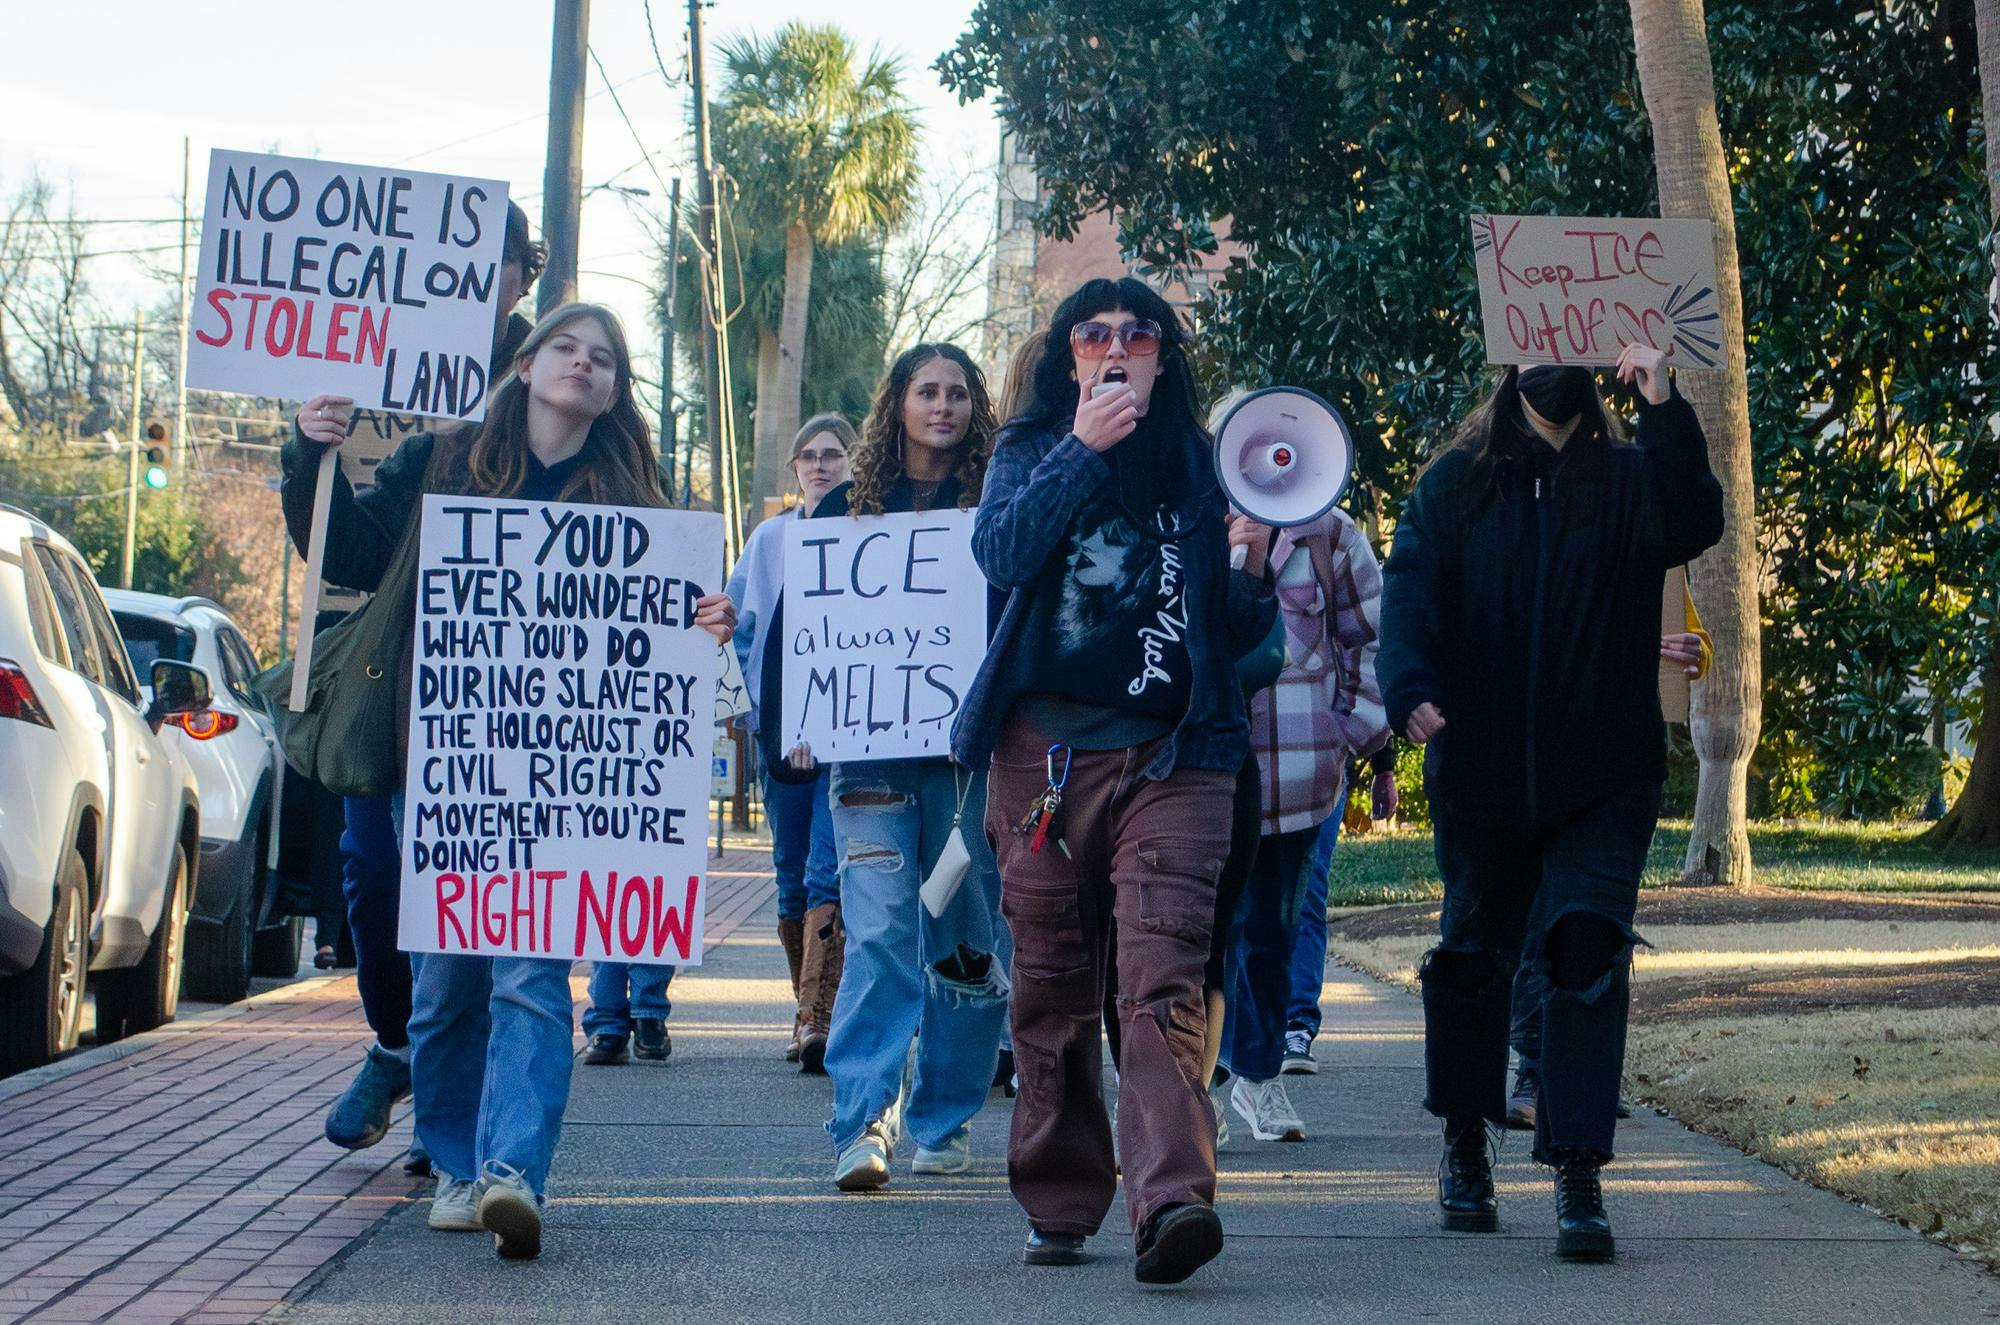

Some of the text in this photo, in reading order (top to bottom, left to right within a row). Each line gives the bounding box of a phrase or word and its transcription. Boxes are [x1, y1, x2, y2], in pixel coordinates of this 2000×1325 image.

[223, 165, 488, 248] NO ONE IS
[216, 229, 496, 309] ILLEGAL ON
[1488, 217, 1574, 298] Keep
[196, 288, 391, 367] STOLEN
[381, 348, 485, 418] LAND
[442, 507, 649, 568] IF YOU'D
[802, 528, 950, 598] ICE
[423, 568, 705, 630] EVER WONDERED
[423, 620, 650, 668] WHAT YOU'D DO
[794, 614, 950, 659] always
[419, 664, 546, 709] DURING
[557, 667, 697, 718] SLAVERY,
[801, 664, 959, 736] MELTS
[419, 711, 694, 759] THE HOLOCAUST, OR
[423, 753, 665, 799] CIVIL RIGHTS
[575, 802, 686, 845] YOU'RE
[414, 838, 538, 874] DOING IT
[435, 870, 699, 960] RIGHT NOW
